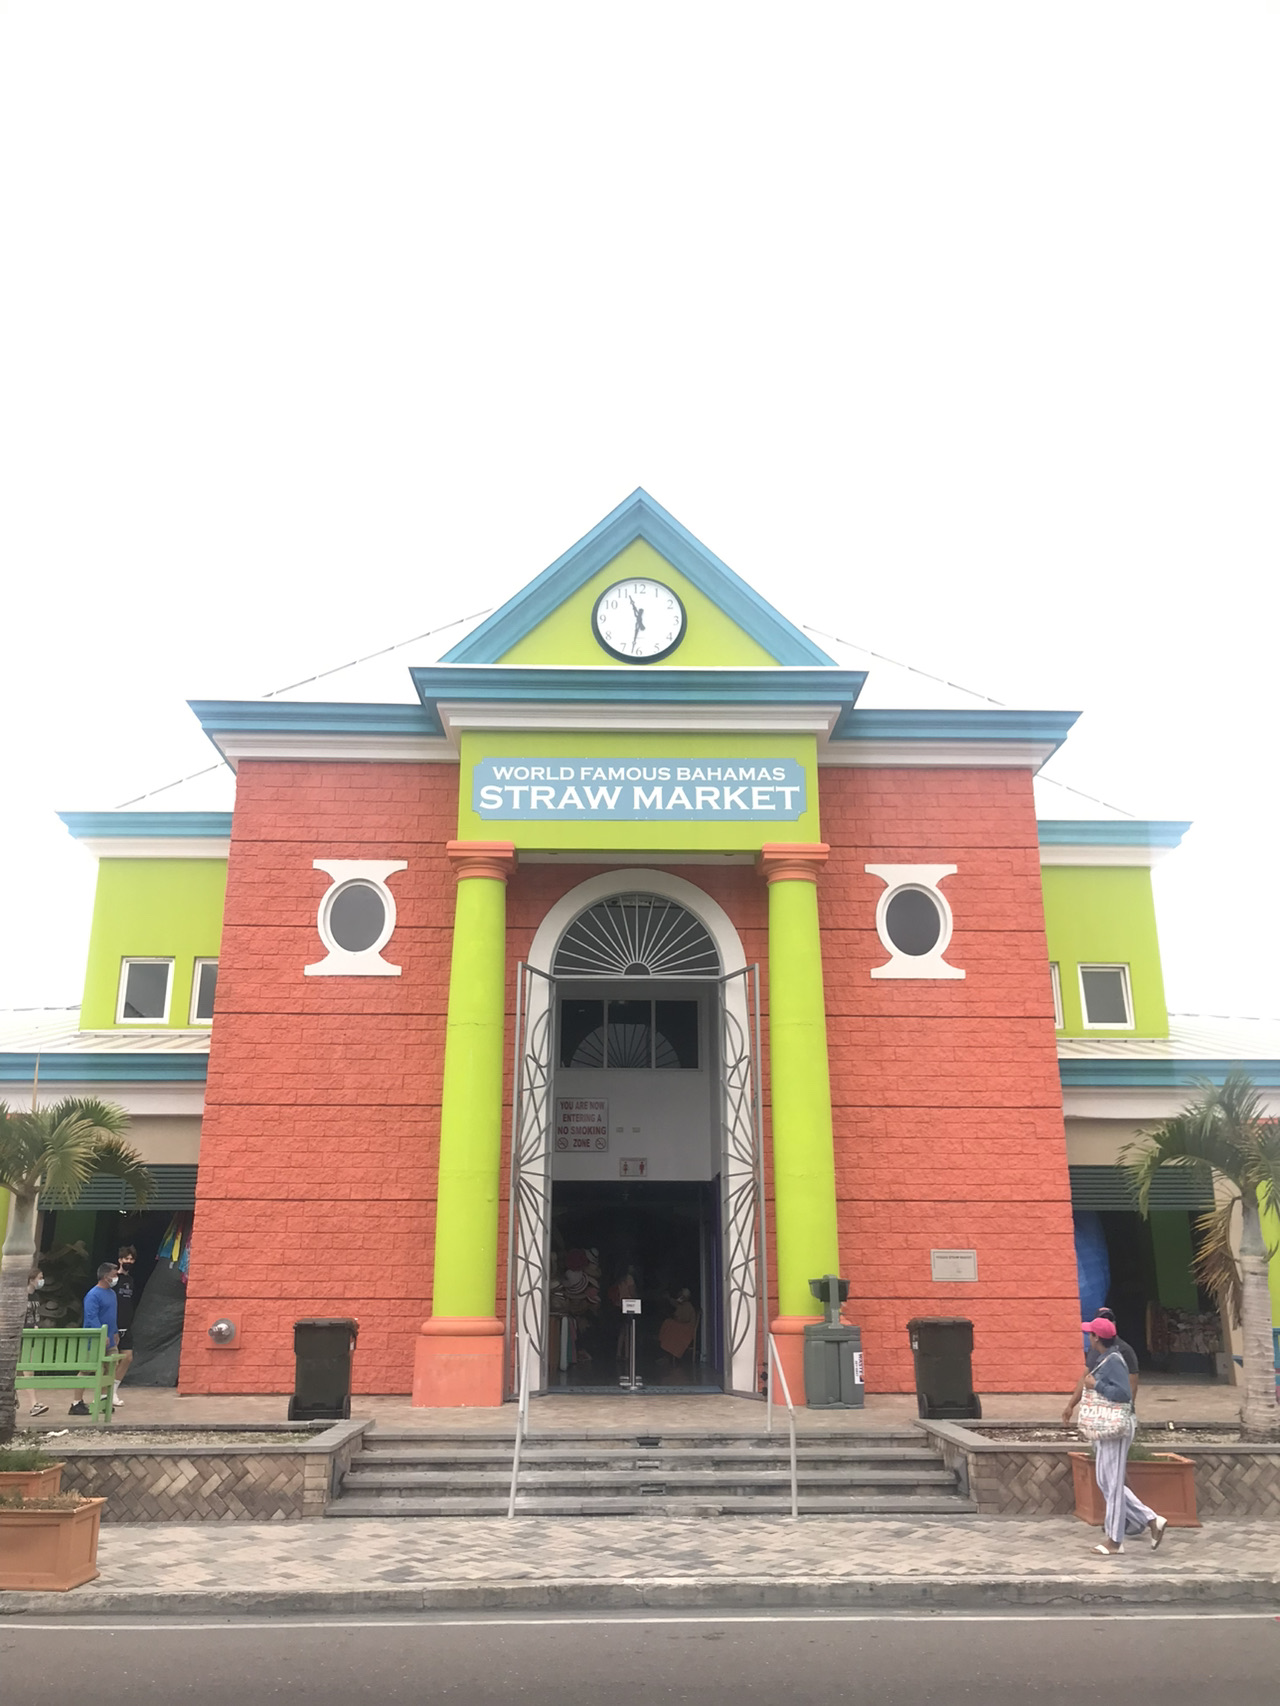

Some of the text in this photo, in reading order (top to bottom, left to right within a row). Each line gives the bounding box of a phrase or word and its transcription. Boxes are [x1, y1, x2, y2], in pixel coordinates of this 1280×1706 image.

[618, 588, 628, 598] 11
[634, 584, 646, 594] 12
[605, 600, 618, 609] 10
[667, 599, 674, 609] 2
[599, 615, 606, 624] 9
[673, 616, 679, 626] 3
[605, 631, 612, 640] 8
[666, 632, 673, 641] 4
[620, 643, 627, 652] 7
[635, 647, 642, 655] 6
[654, 643, 660, 653] 5
[492, 766, 786, 781] WORLD FAMOUS BAHAMAS
[479, 785, 800, 811] STRAW MARKET
[560, 1101, 605, 1110] YOU ARE NOW
[562, 1114, 602, 1122] ENTERING A
[557, 1126, 607, 1135] NO SMOKING
[573, 1139, 591, 1148] ZONE
[1080, 1405, 1124, 1419] OZUMEL
